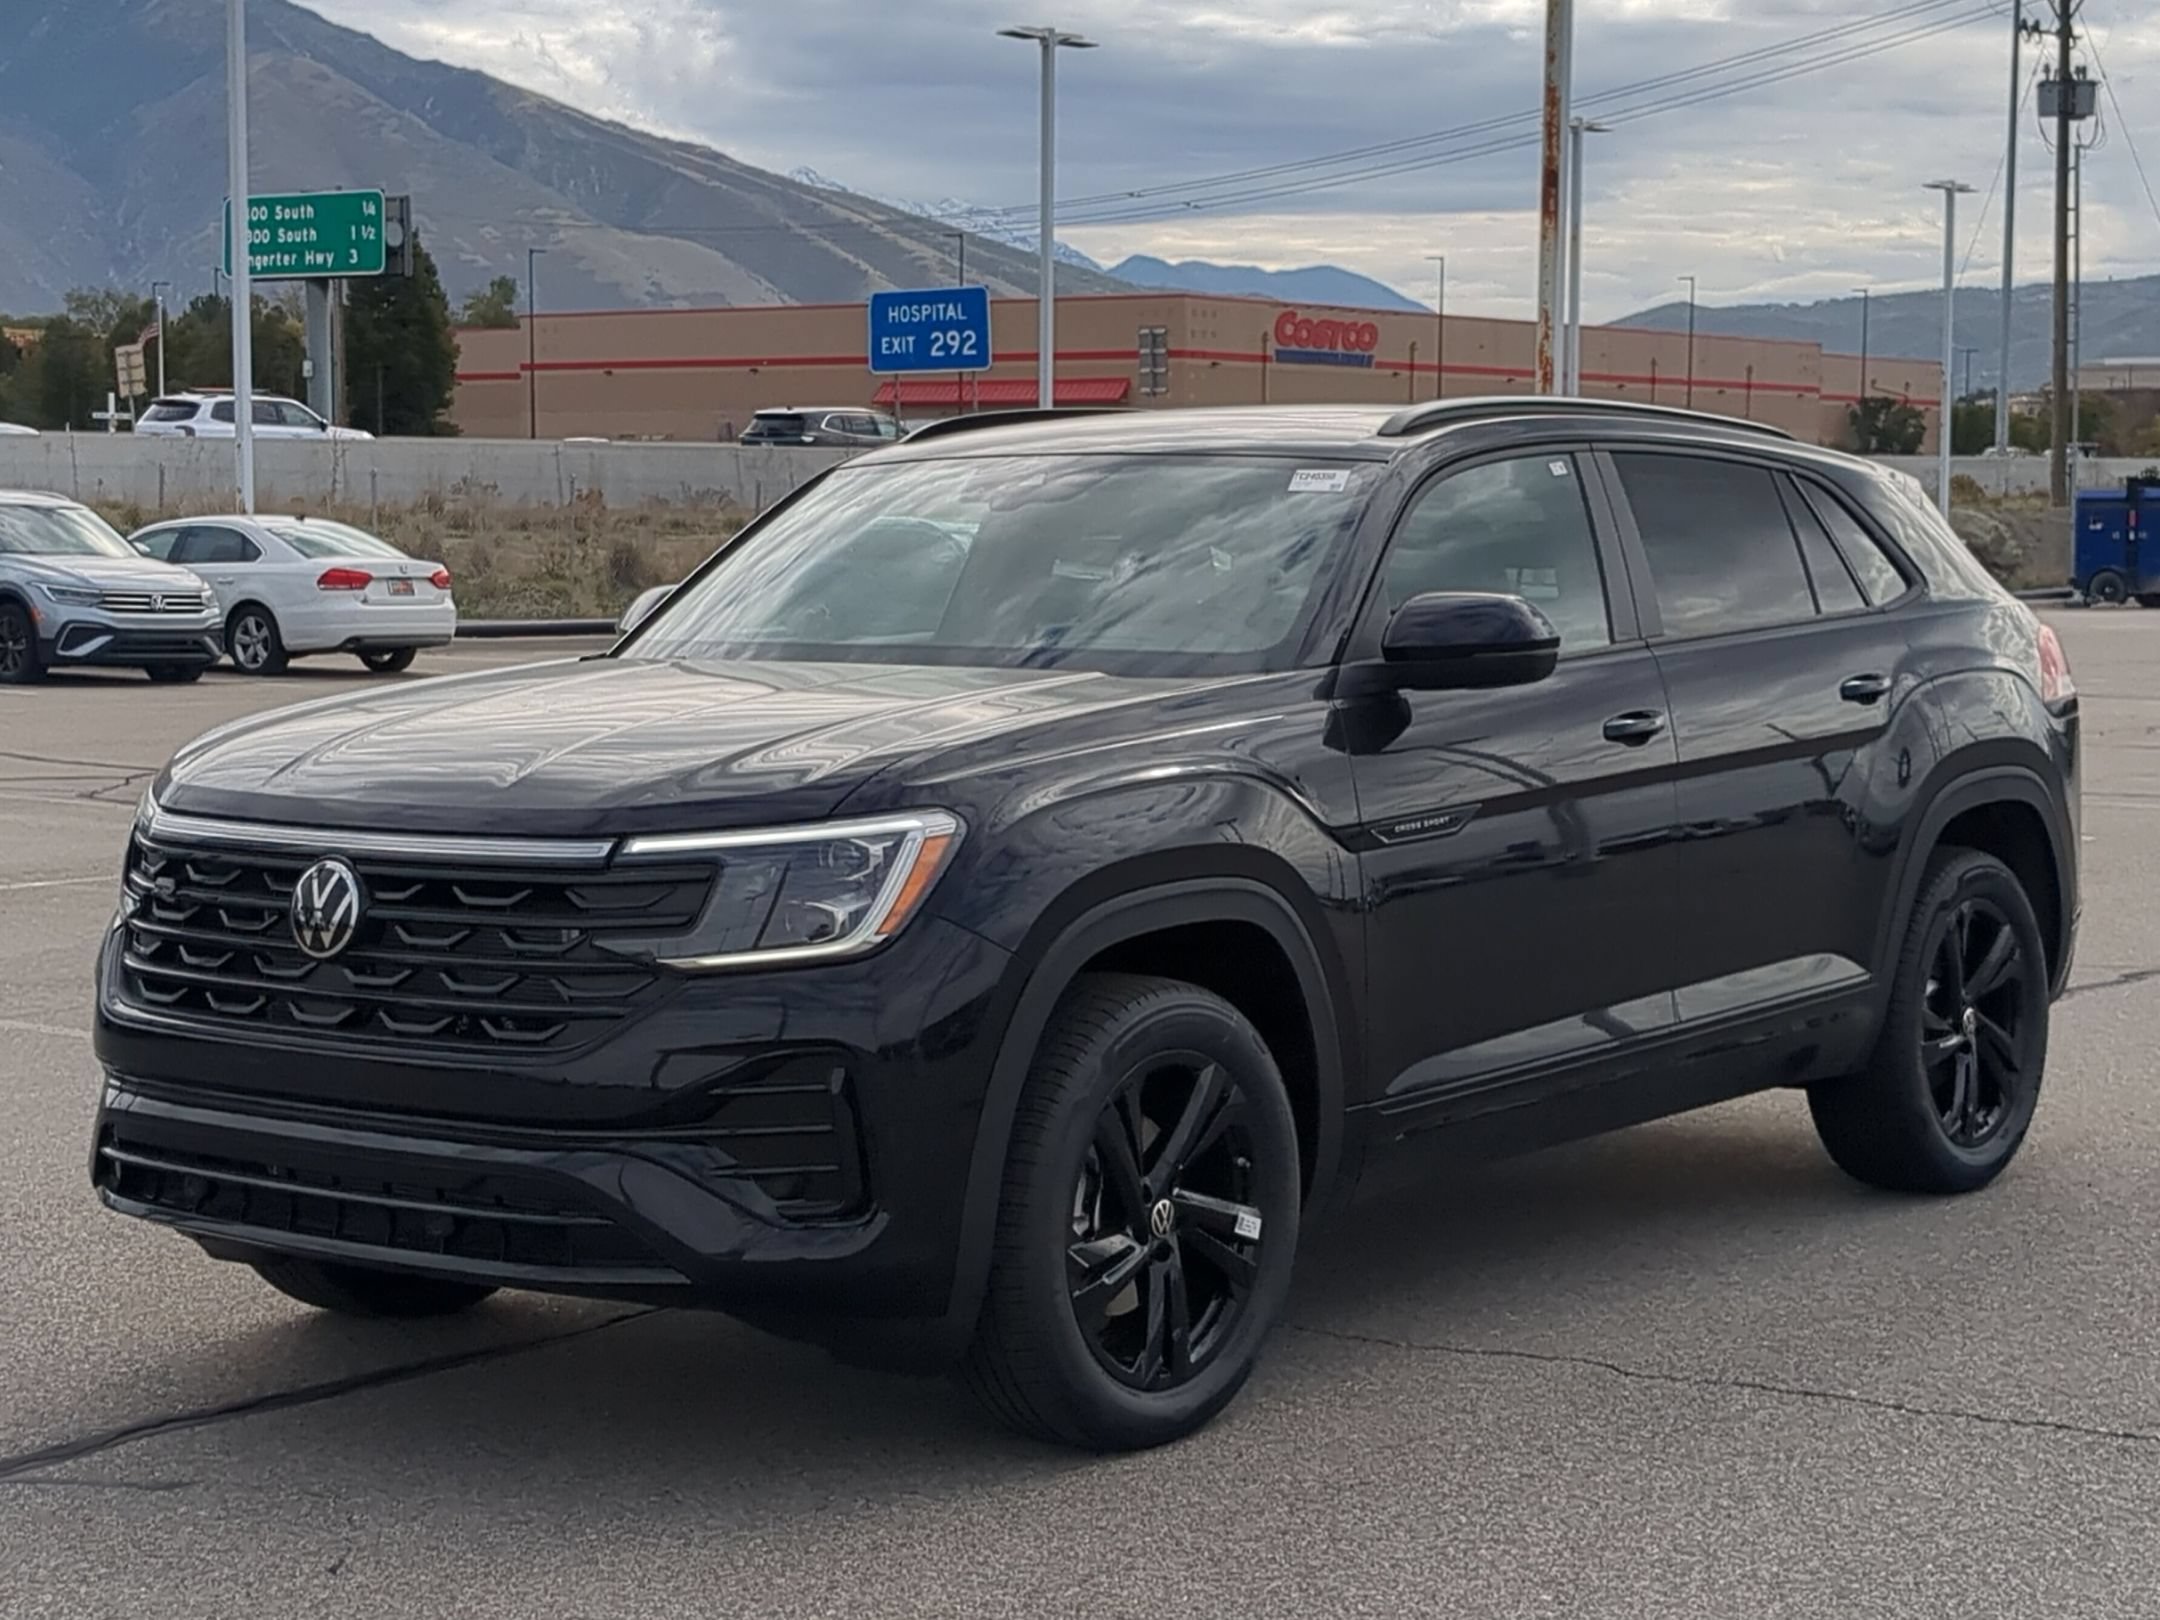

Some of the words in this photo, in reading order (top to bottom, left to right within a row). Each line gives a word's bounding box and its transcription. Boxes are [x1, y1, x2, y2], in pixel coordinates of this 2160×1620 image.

[275, 204, 314, 220] South
[277, 227, 317, 243] South
[248, 252, 297, 270] ngerter
[305, 250, 334, 268] Hwy
[349, 249, 358, 264] 3
[888, 303, 968, 323] HOSPITAL
[881, 336, 916, 354] EXIT
[930, 330, 977, 357] 292
[293, 860, 359, 958] VW
[1151, 1199, 1174, 1238] VW
